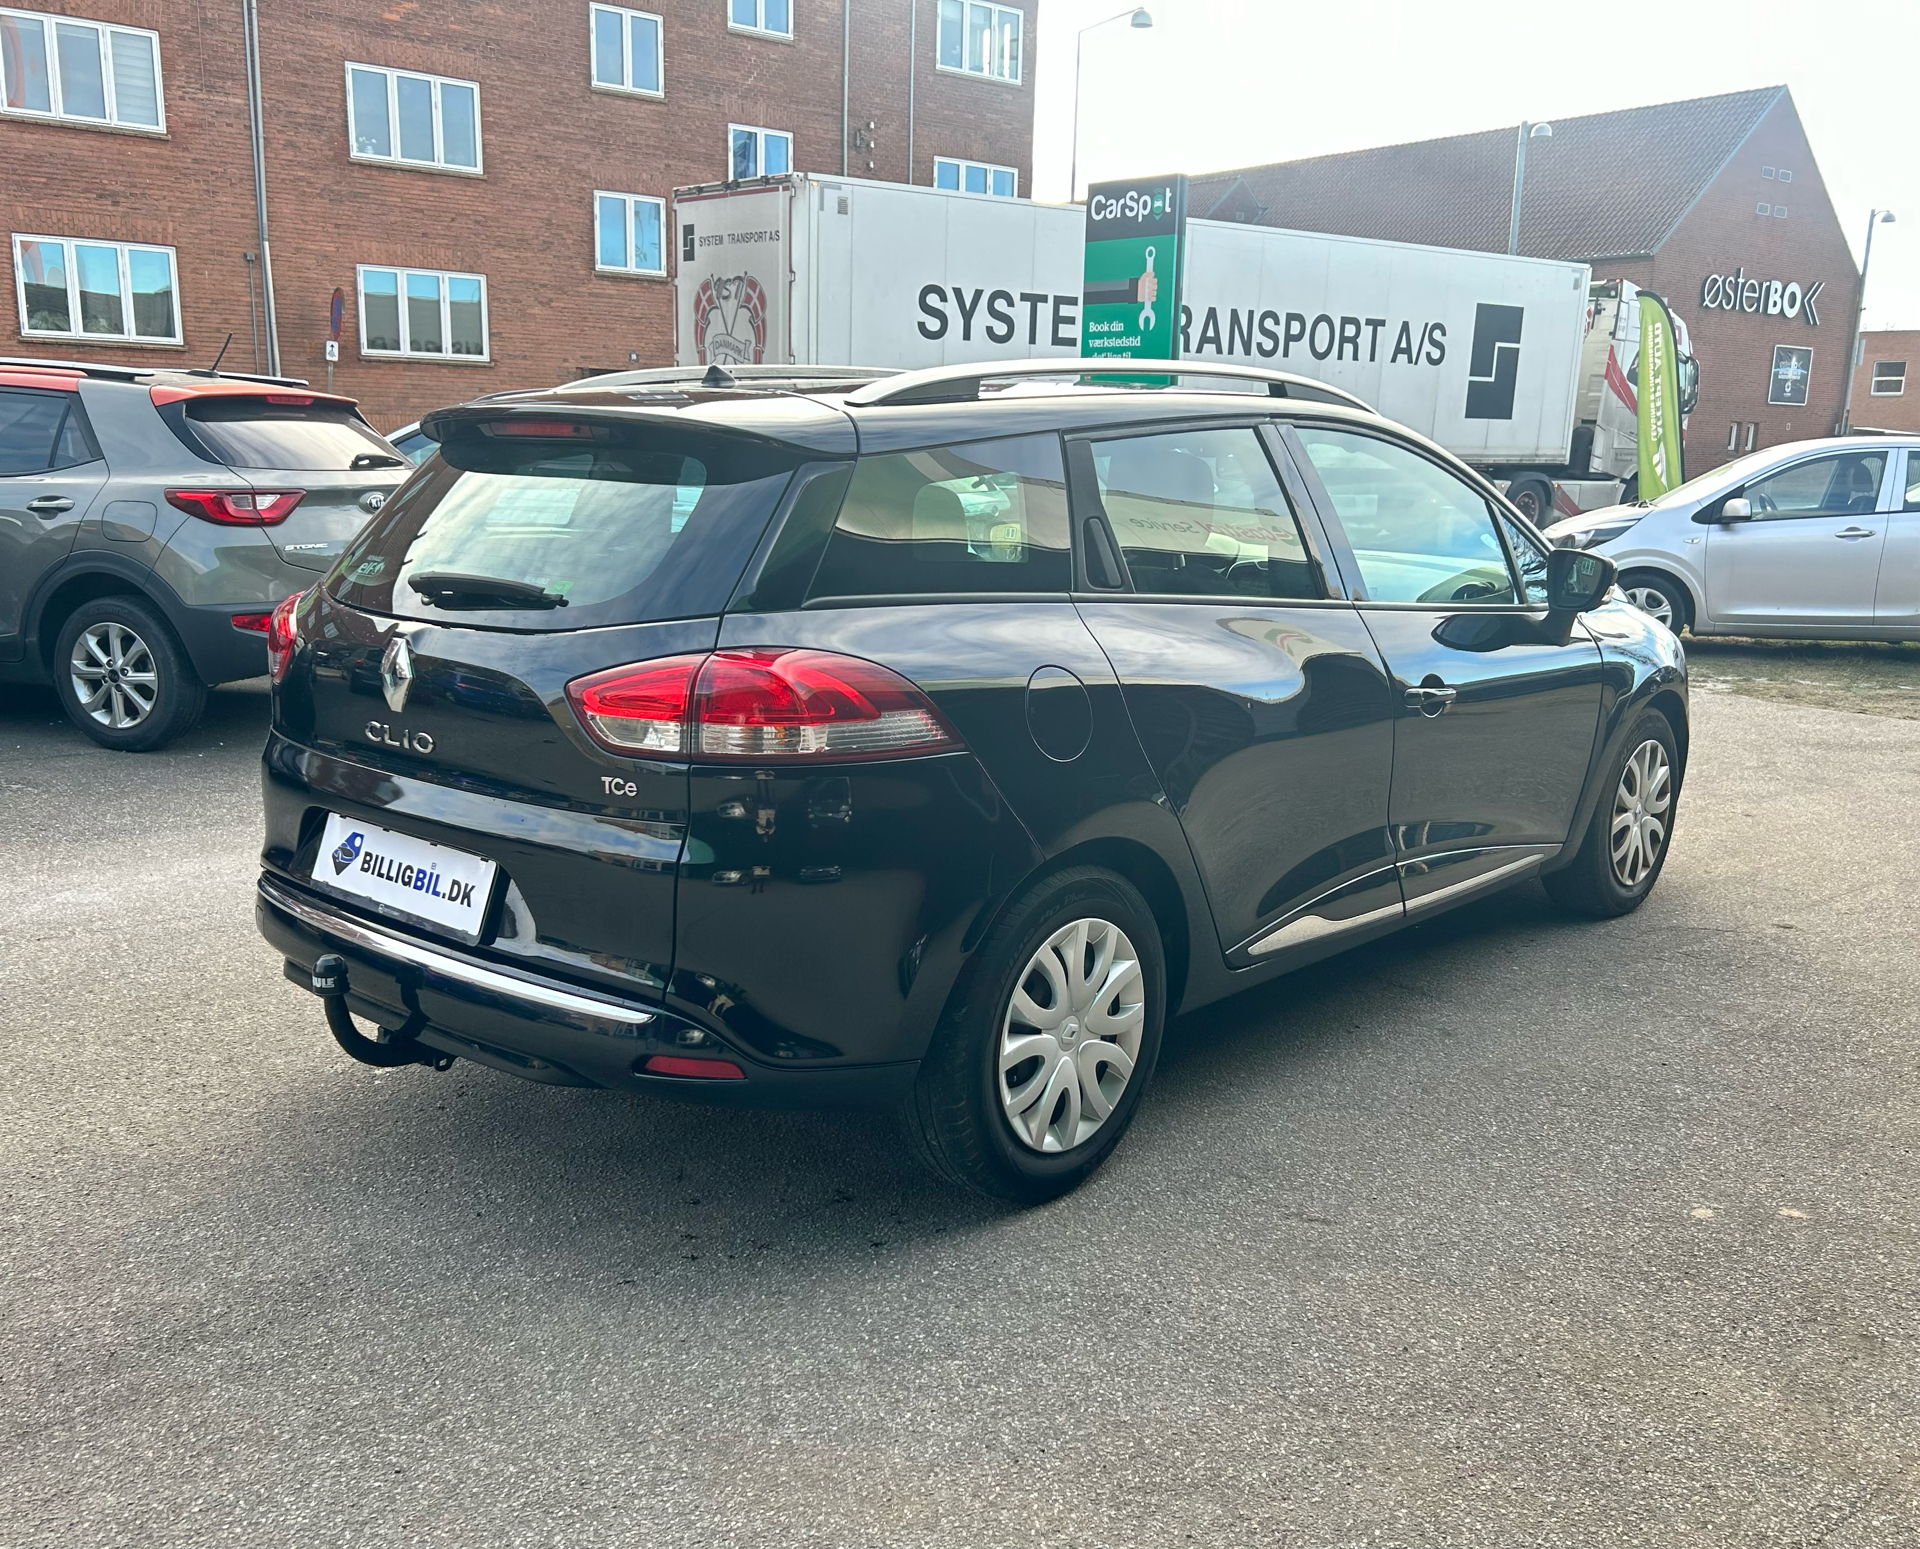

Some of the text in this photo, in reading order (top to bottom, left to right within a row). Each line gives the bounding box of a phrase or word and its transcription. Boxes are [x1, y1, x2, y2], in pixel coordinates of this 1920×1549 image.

[698, 229, 780, 247] SYSTEM TRANSPORT A/S
[916, 283, 1447, 367] SYSTE RANSPORT A/S
[1088, 320, 1124, 333] Book din
[714, 340, 744, 359] DANMARK
[1088, 335, 1141, 348] værkstedstid
[284, 542, 329, 551] STONIC
[364, 720, 436, 754] CLIO
[600, 776, 638, 798] TCe
[360, 850, 476, 908] BILLIGBIL.DK
